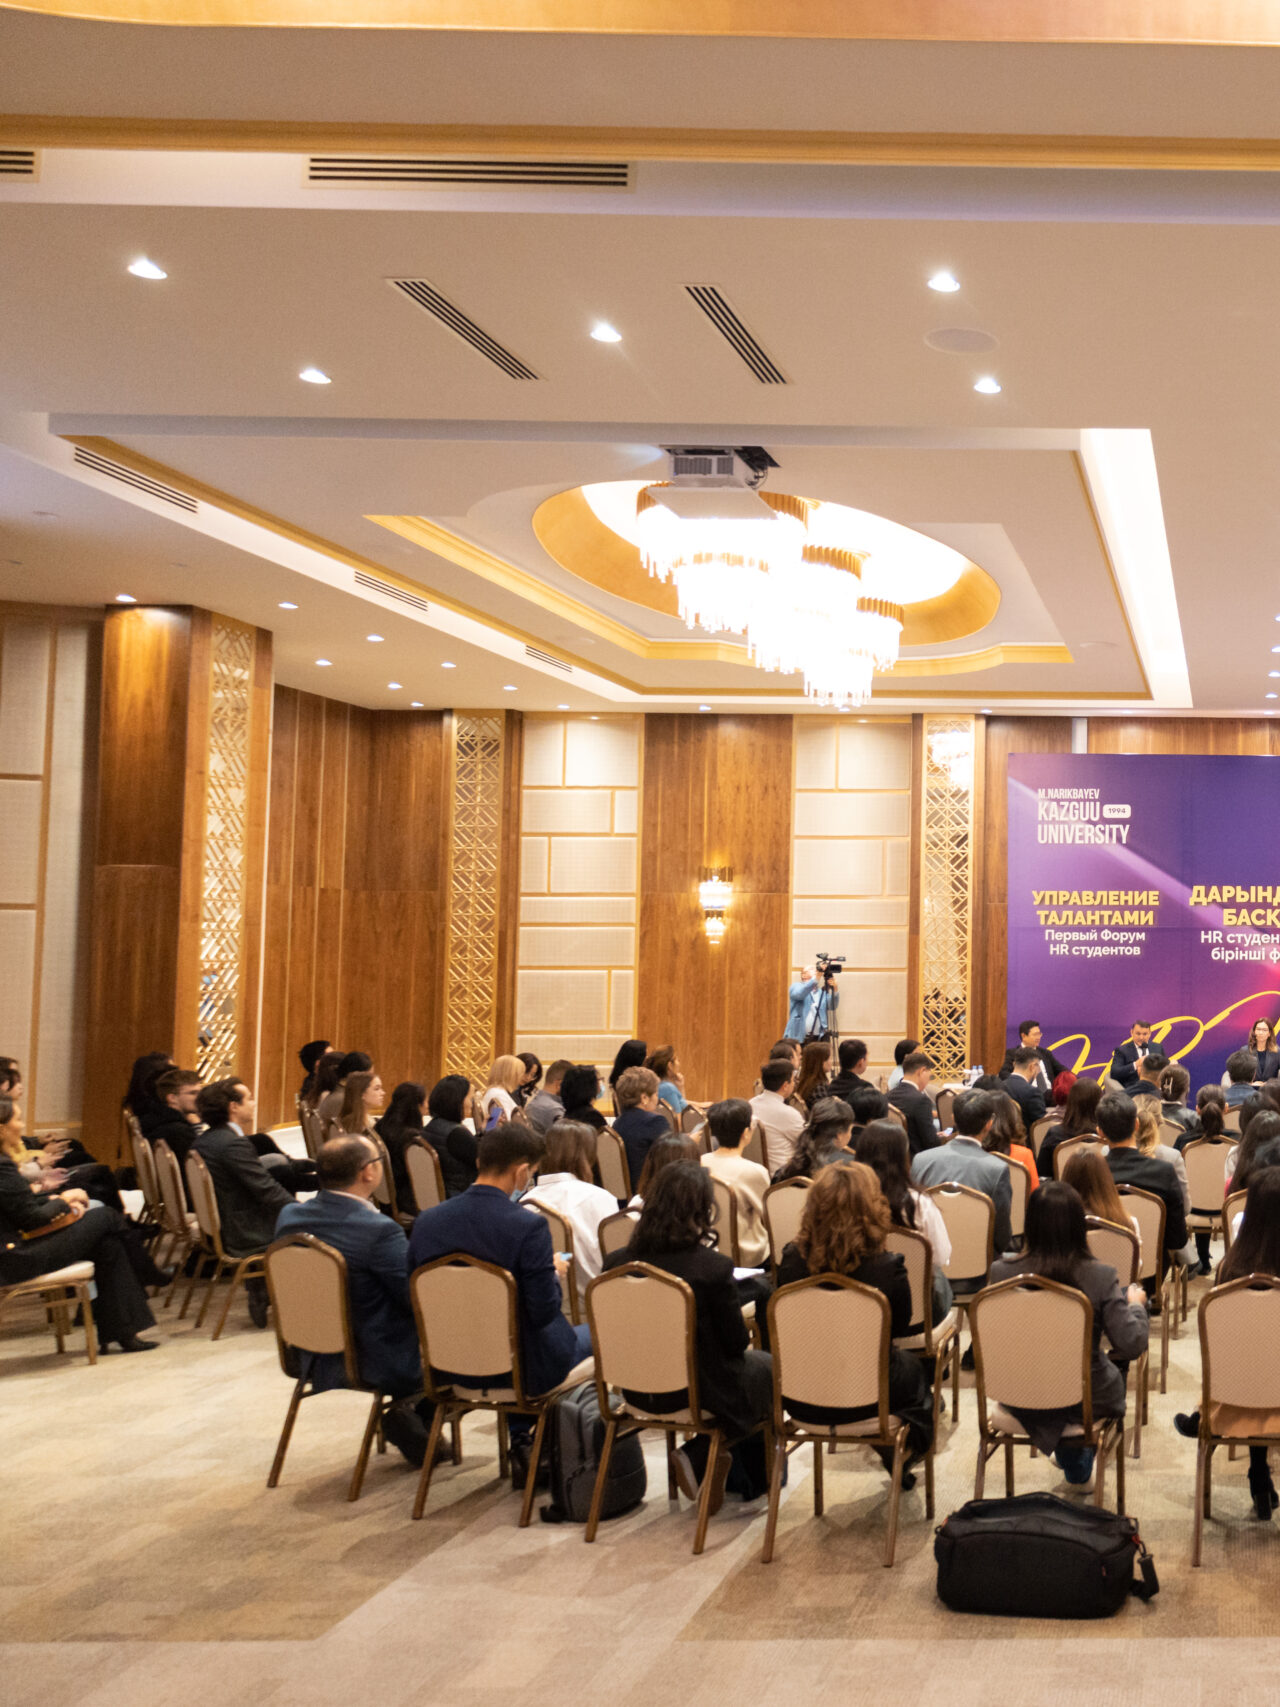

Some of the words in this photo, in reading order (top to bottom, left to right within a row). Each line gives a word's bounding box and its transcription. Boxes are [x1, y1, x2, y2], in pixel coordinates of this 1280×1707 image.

[1038, 788, 1100, 800] M.NARIKBAYEV
[1038, 801, 1100, 821] KAZGUU
[1037, 824, 1130, 844] UNIVERSITY
[1032, 890, 1160, 906] УПРАВЛЕНИЕ
[1036, 910, 1154, 925] ТАЛАНТАМИ
[1045, 929, 1098, 943] Первый
[1100, 928, 1146, 943] Форум
[1200, 930, 1223, 944] HR
[1049, 944, 1069, 955] HR
[1072, 945, 1141, 958] студентов
[1211, 947, 1266, 963] бірінші
